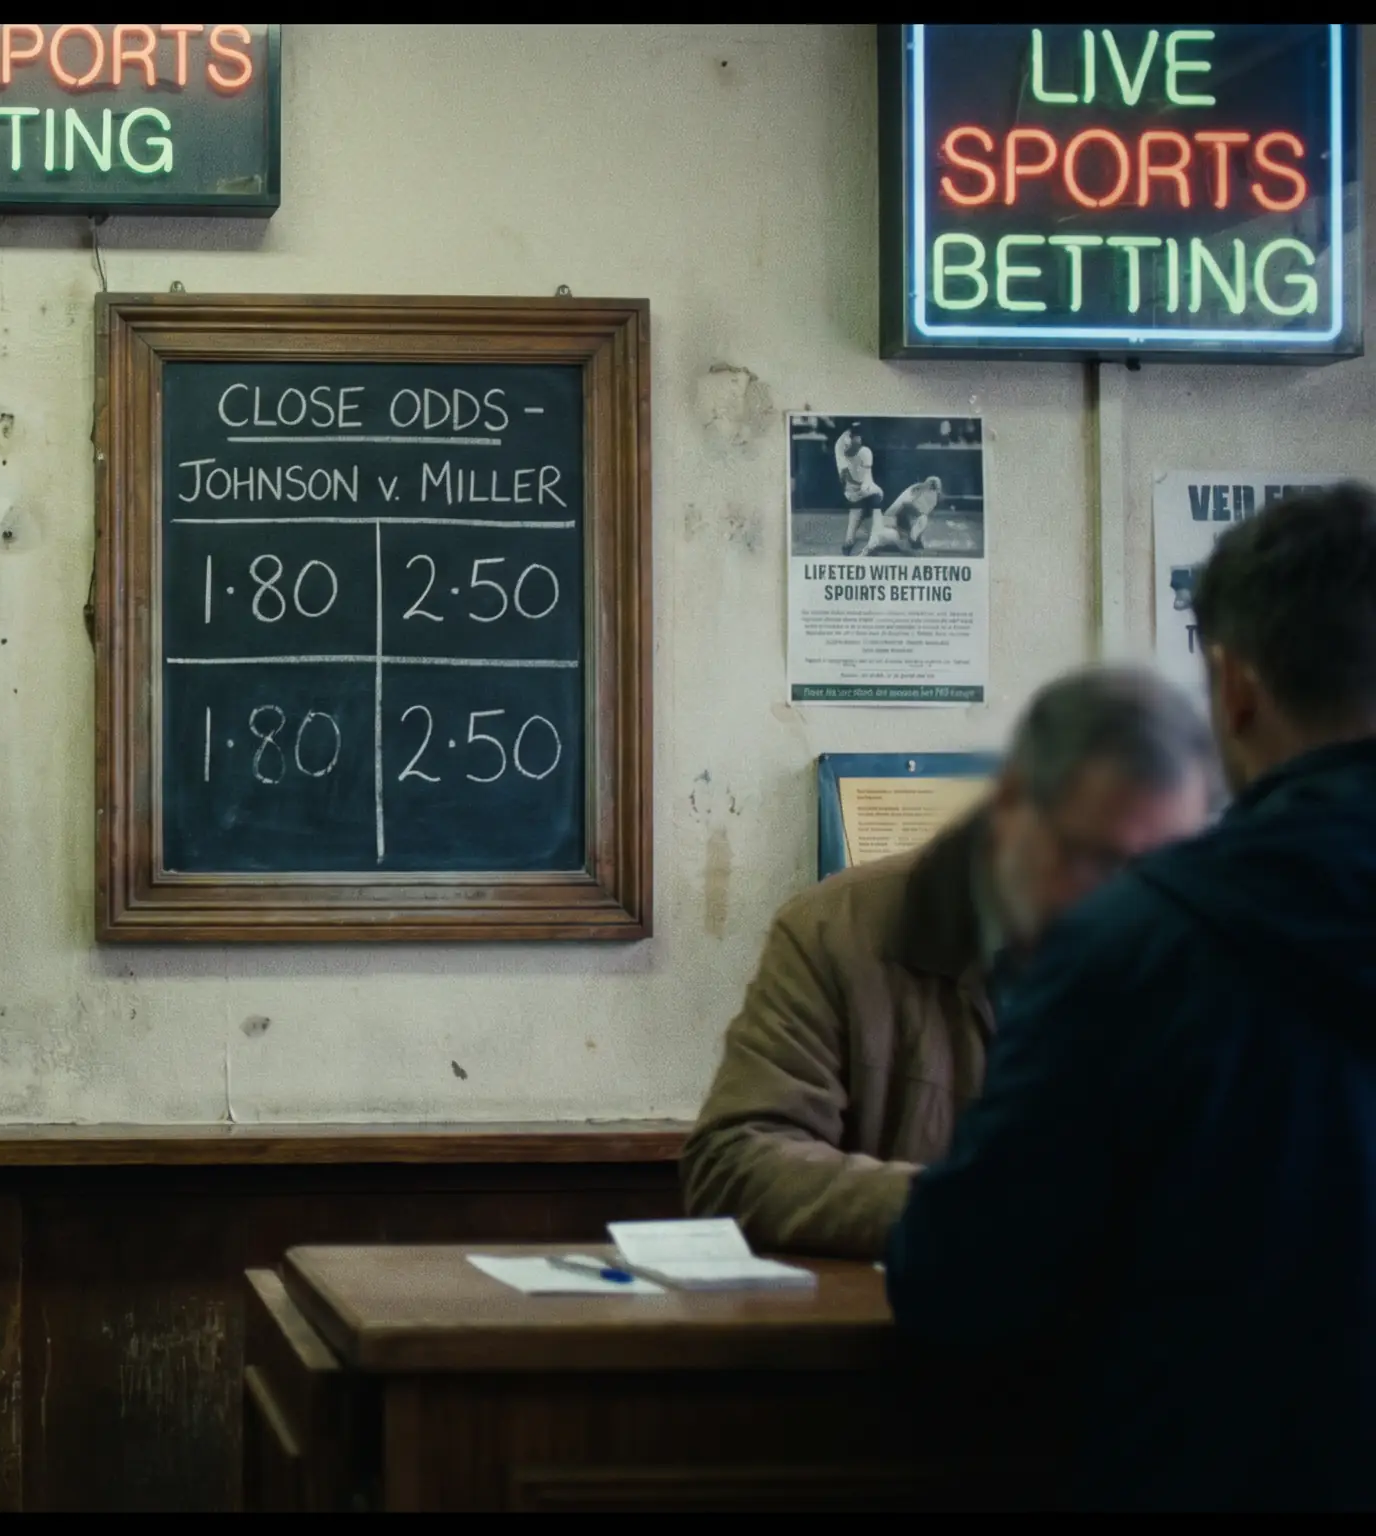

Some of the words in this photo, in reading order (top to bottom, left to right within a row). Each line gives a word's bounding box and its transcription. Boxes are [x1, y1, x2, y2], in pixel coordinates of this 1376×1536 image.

[1031, 28, 1217, 106] LIVE
[940, 125, 1309, 212] SPORTS
[932, 232, 1320, 317] BETTING
[217, 382, 365, 428] CLOSE
[389, 387, 510, 431] ODDS
[177, 457, 360, 502] JOHNSON
[420, 460, 568, 507] MILLER
[869, 565, 908, 581] WITH
[890, 585, 953, 602] BETTING
